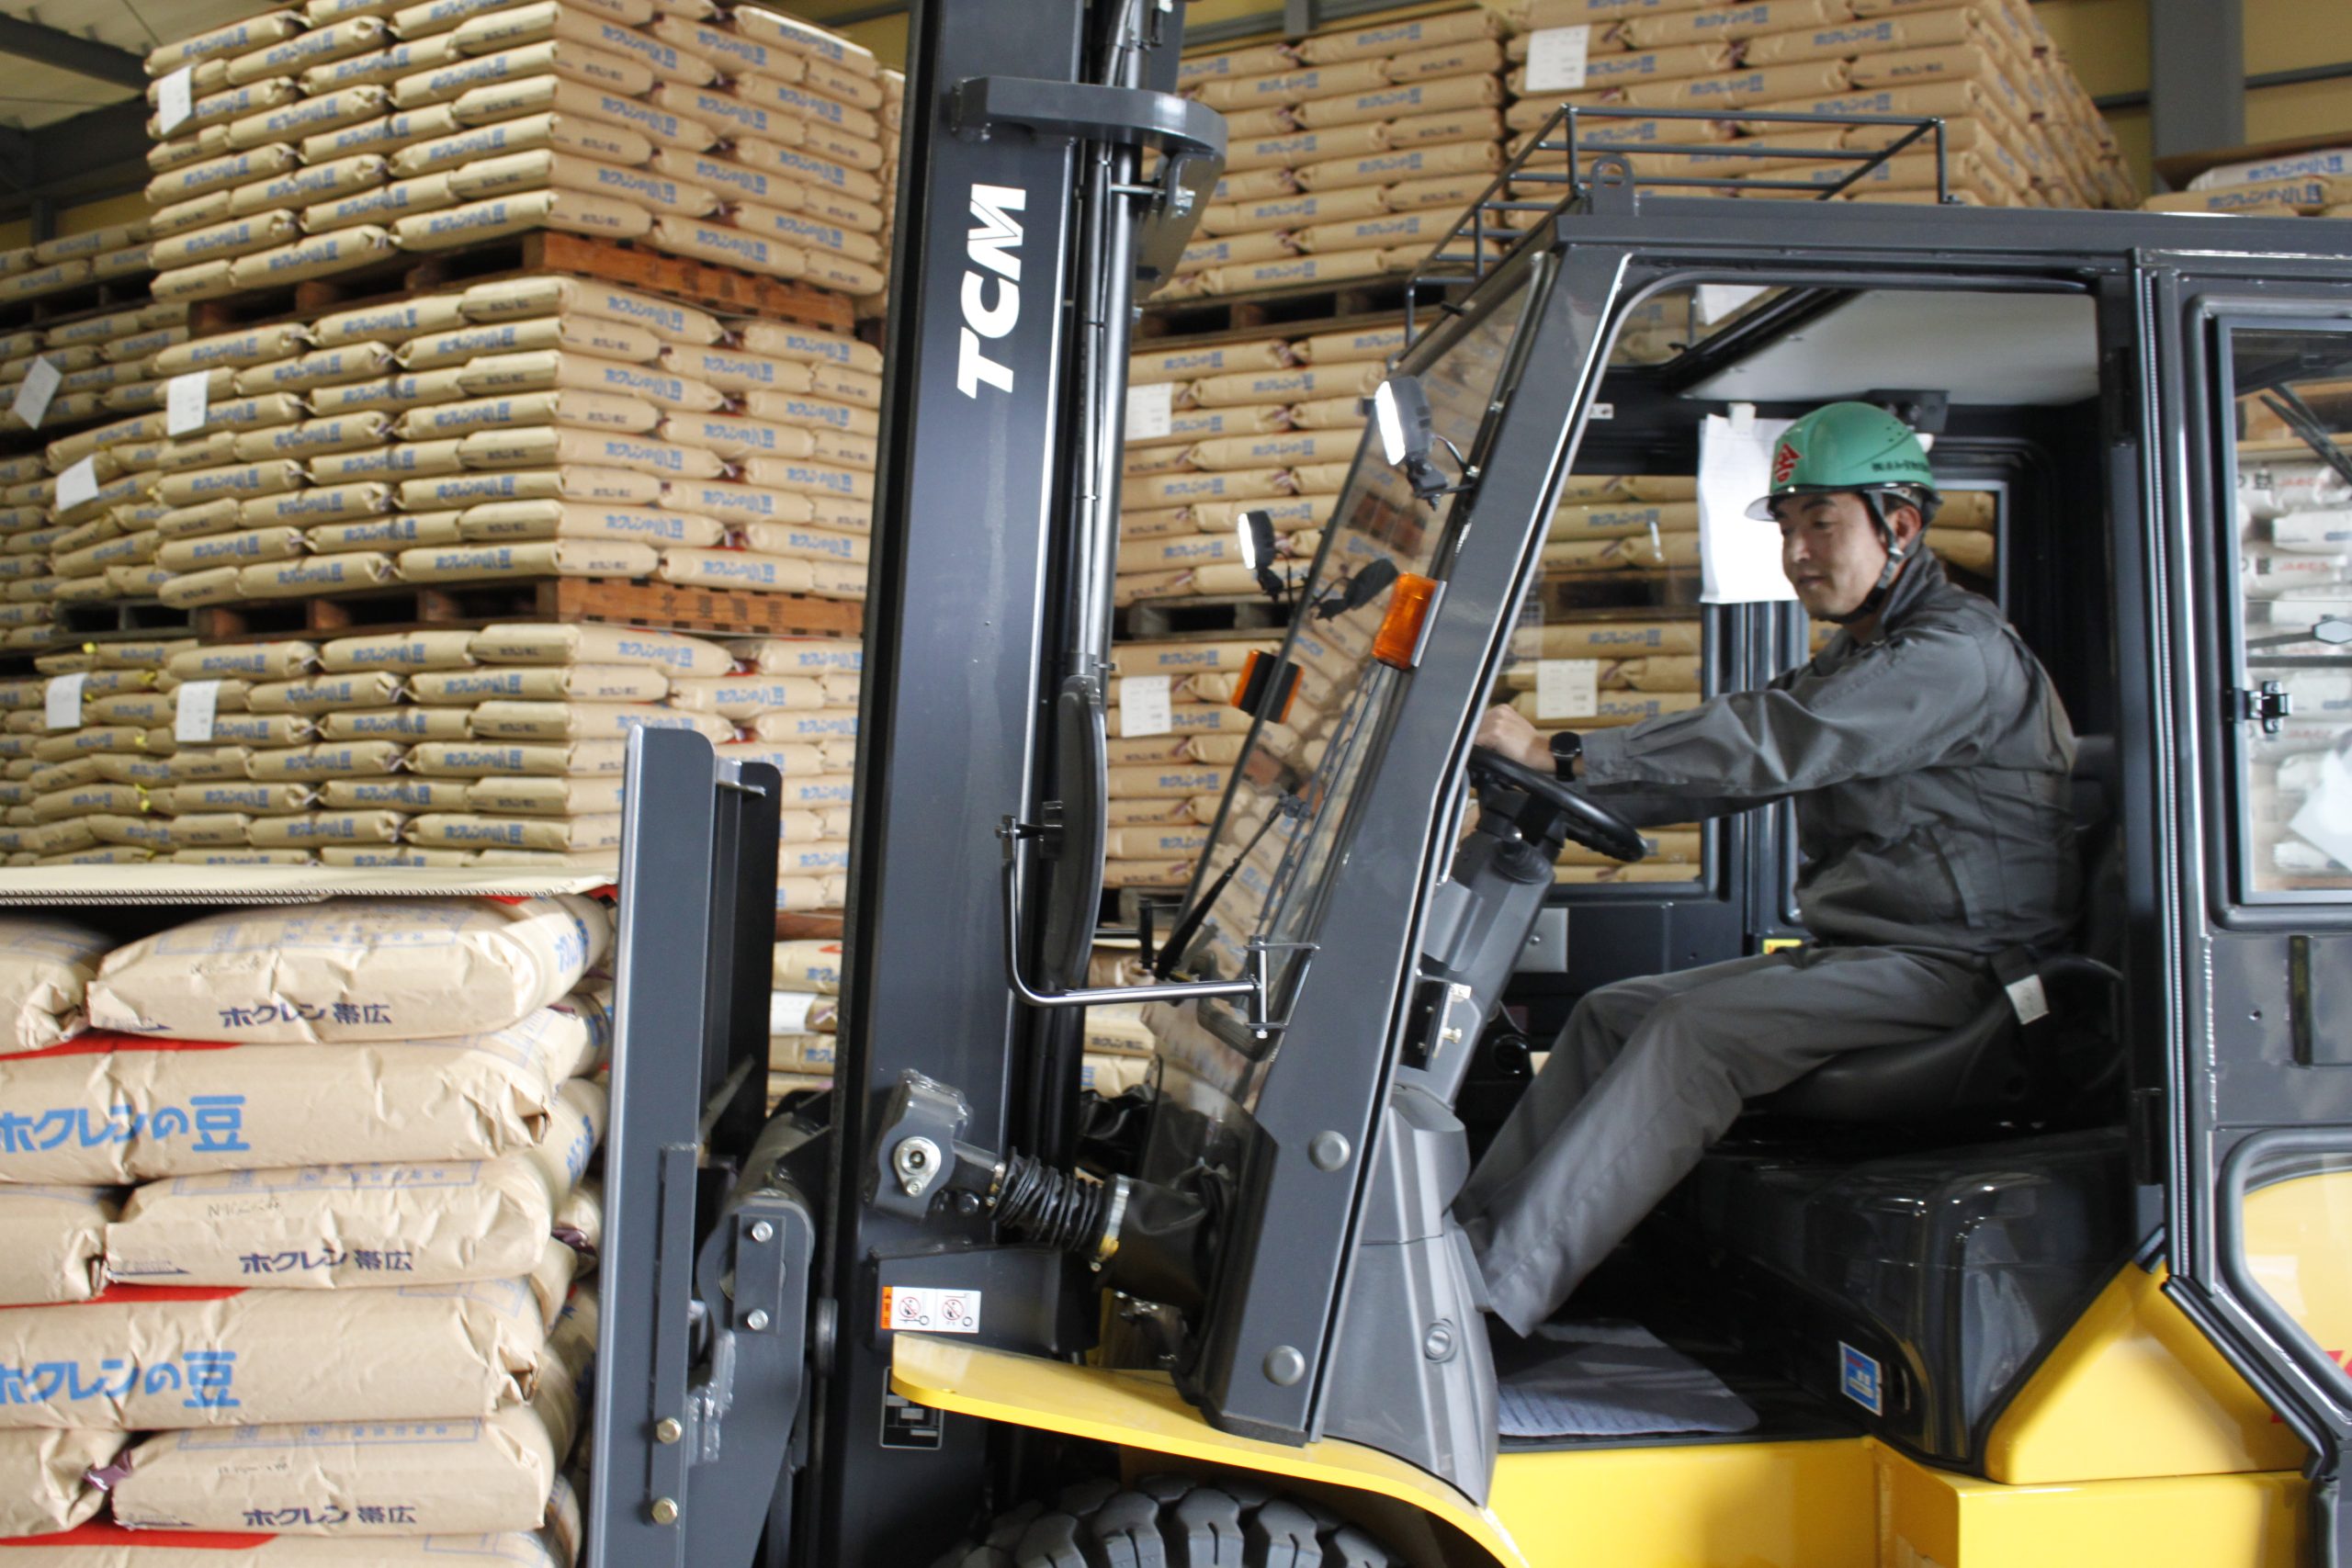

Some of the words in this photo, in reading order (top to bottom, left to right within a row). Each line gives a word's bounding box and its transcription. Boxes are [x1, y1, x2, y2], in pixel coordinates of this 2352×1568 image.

[956, 184, 1027, 400] TCM
[0, 1095, 251, 1153] ホクレンの豆
[0, 1351, 241, 1408] ホクレンの豆
